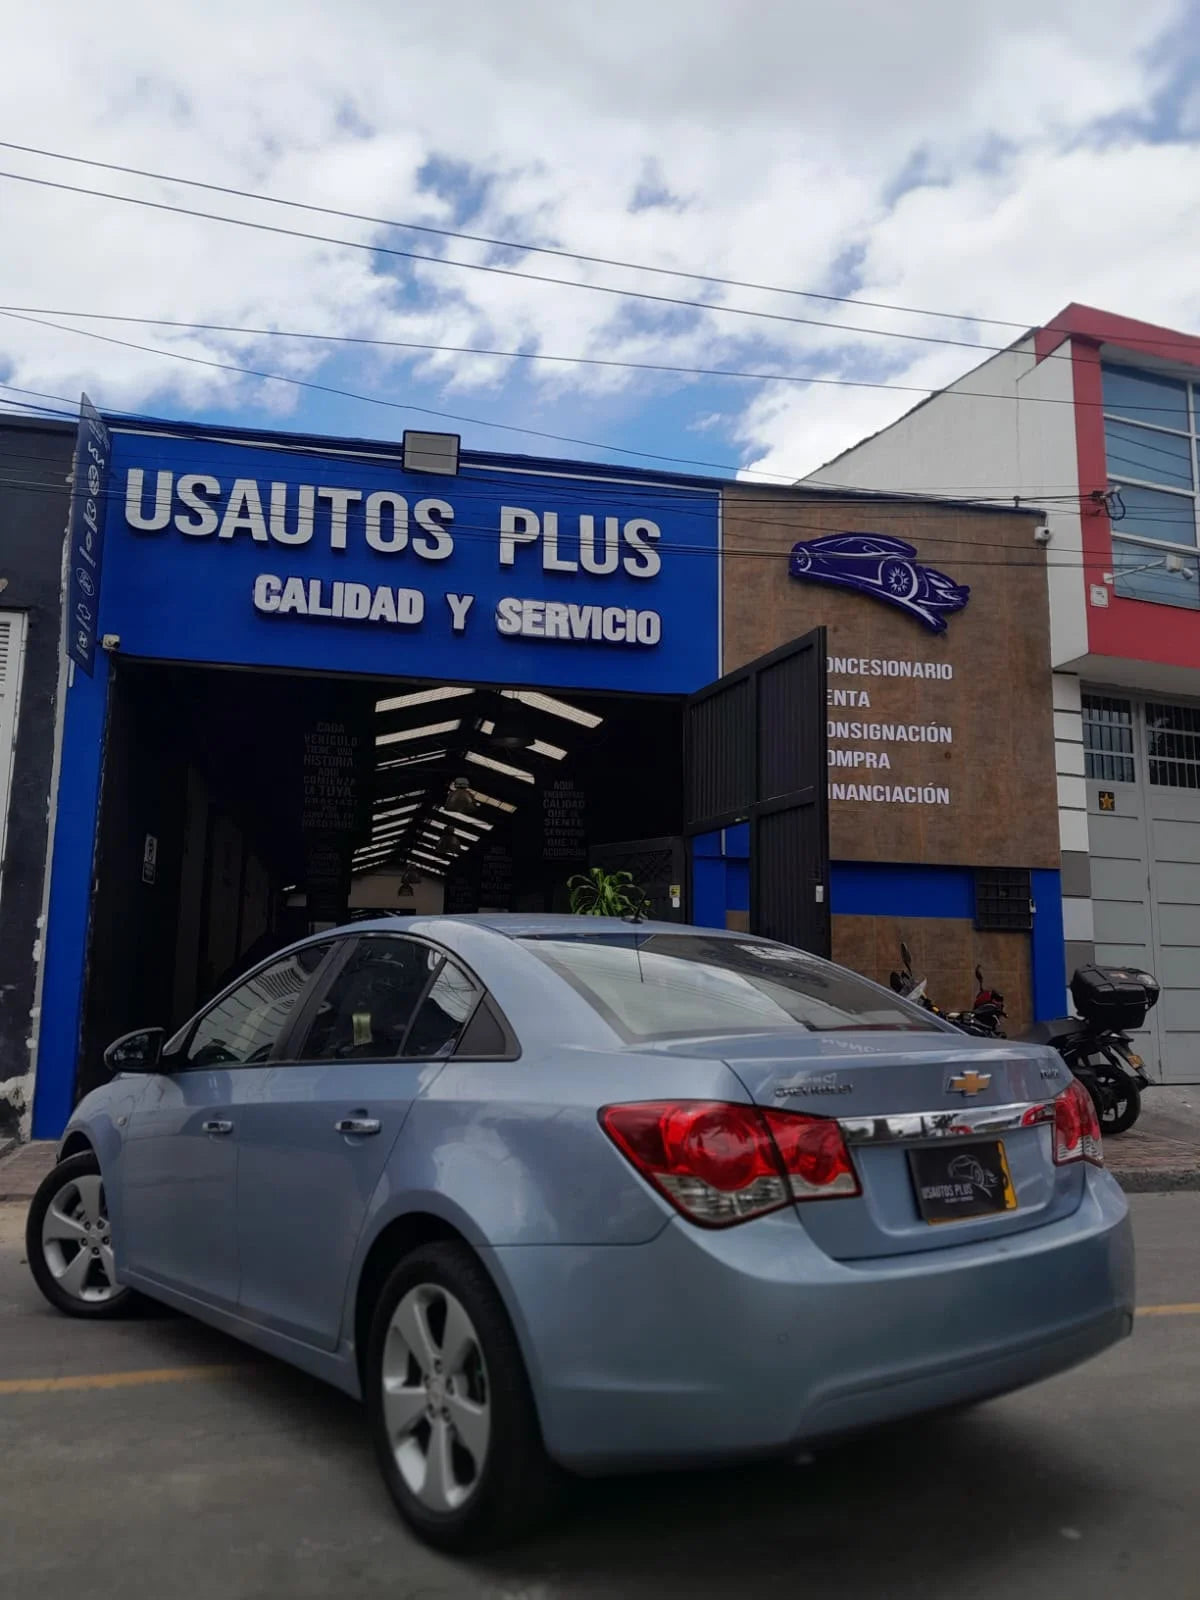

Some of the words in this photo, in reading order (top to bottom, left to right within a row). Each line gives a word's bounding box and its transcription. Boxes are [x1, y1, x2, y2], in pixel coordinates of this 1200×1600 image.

[124, 467, 456, 560] USAUTOS
[499, 505, 662, 578] PLUS
[253, 573, 425, 625] CALIDAD
[446, 593, 474, 630] Y
[496, 597, 661, 645] SERVICIO
[826, 656, 953, 680] ONCESIONARIO
[826, 688, 871, 708] ENTA
[826, 720, 953, 743] ONSIGNACIÓN
[826, 749, 891, 769] OMPRA
[827, 782, 950, 805] INANCIACIÓN
[954, 1183, 973, 1197] PLUS
